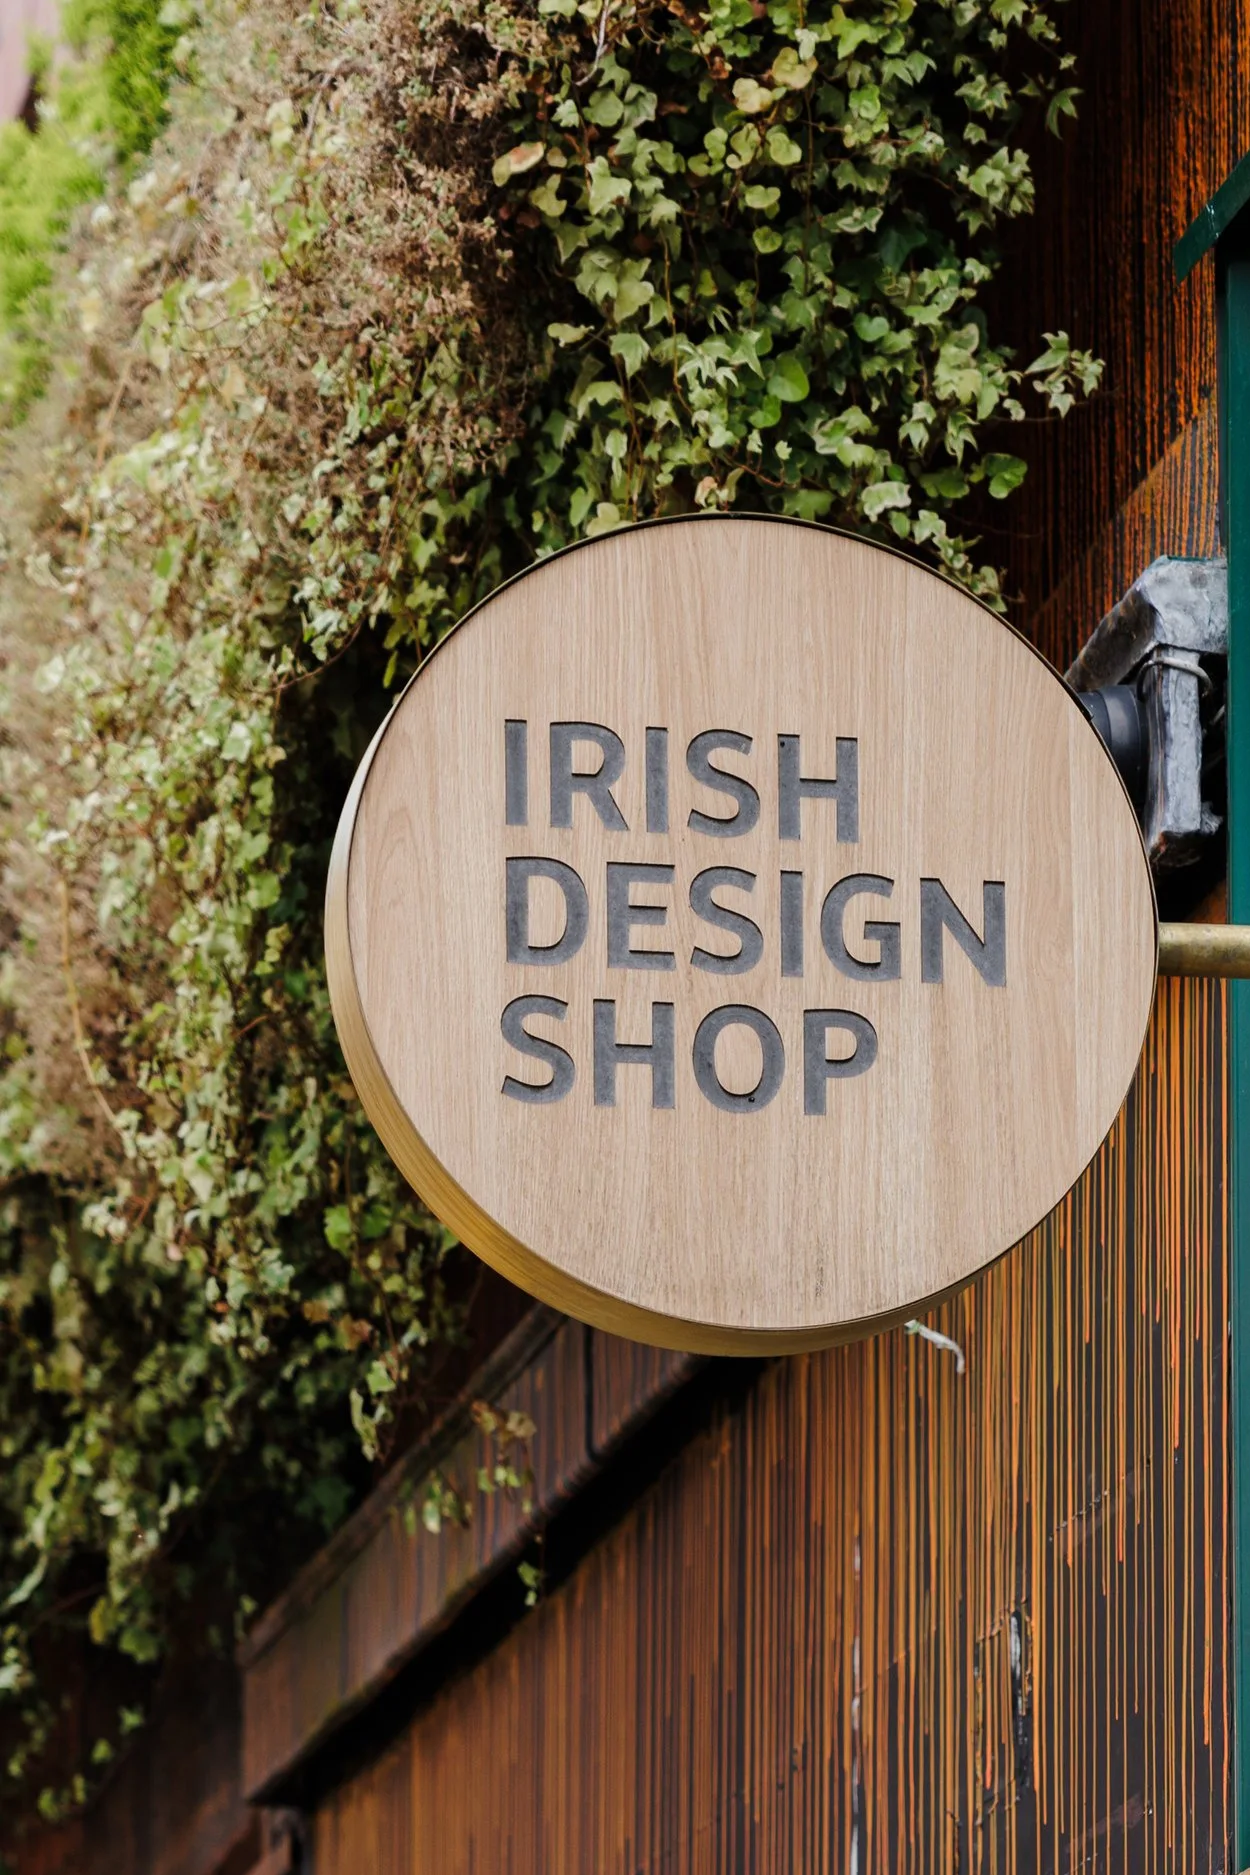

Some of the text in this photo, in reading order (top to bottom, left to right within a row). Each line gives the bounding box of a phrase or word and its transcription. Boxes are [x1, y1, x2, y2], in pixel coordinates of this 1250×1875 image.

[504, 718, 859, 843] IRISH
[505, 856, 1007, 988] DESIGN
[500, 994, 879, 1117] SHOP
